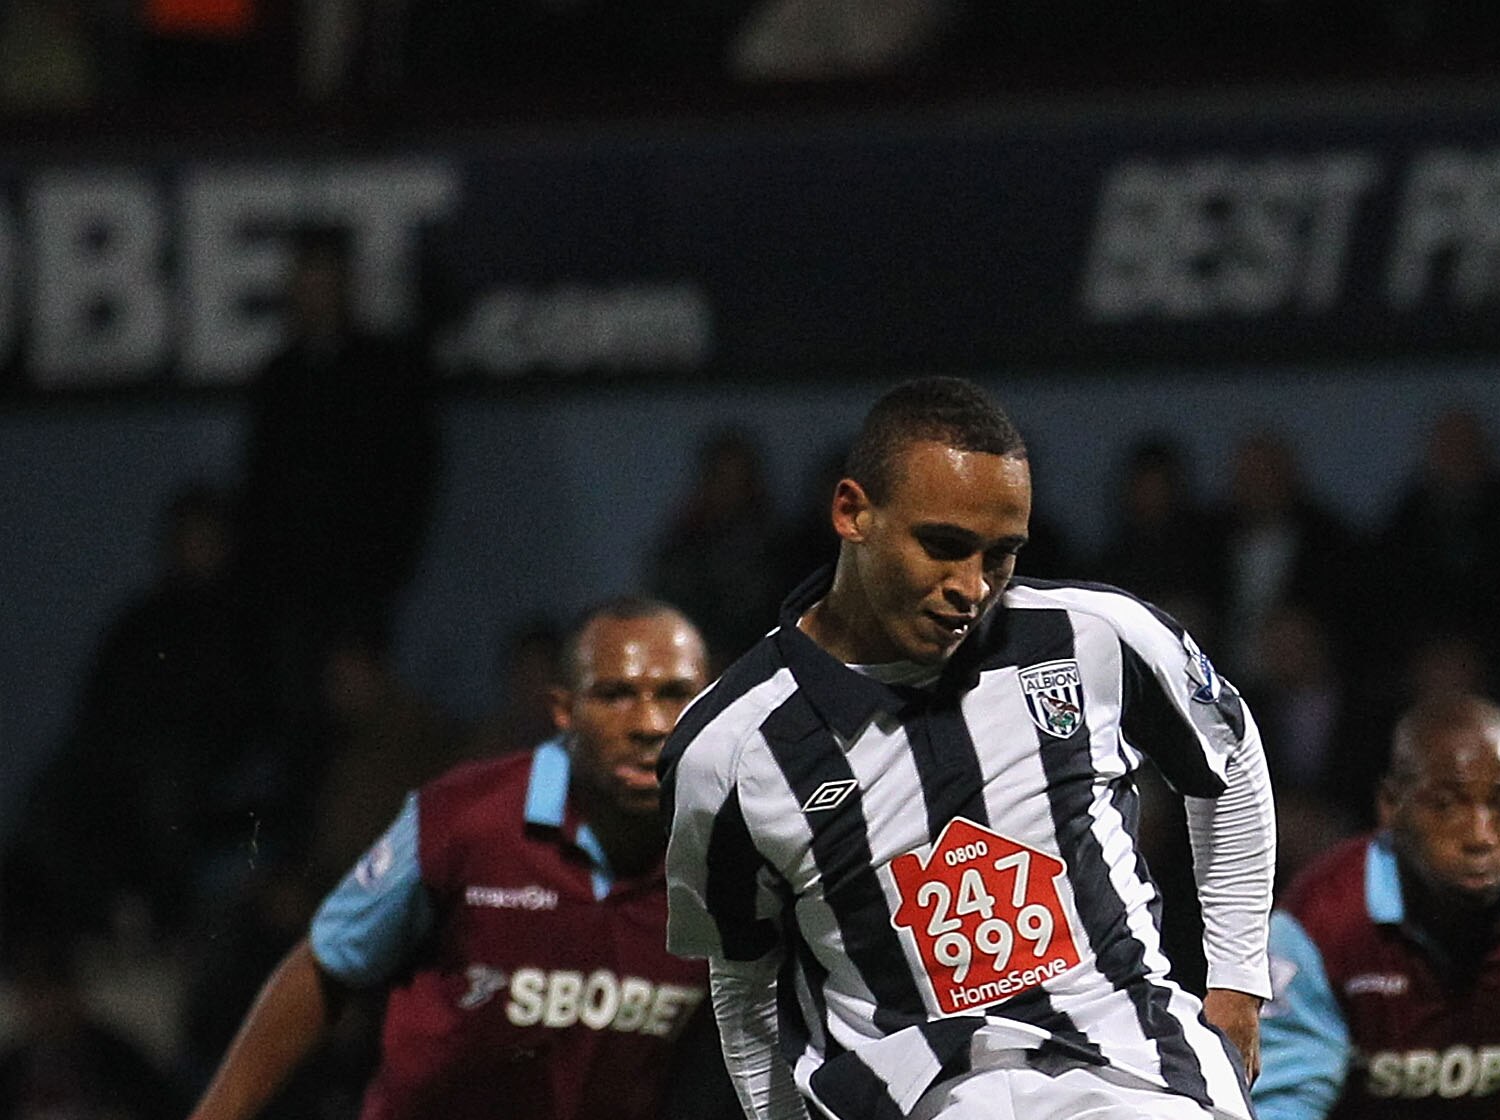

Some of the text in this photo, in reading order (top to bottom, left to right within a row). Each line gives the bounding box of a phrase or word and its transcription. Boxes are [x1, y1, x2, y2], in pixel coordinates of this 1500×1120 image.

[0, 154, 462, 390] BET
[1082, 152, 1384, 322] BEST
[1025, 671, 1078, 692] ALBION
[945, 841, 988, 866] 0800
[917, 851, 1030, 936] 247
[934, 904, 1054, 983] 999
[950, 958, 1067, 1008] HomeServe
